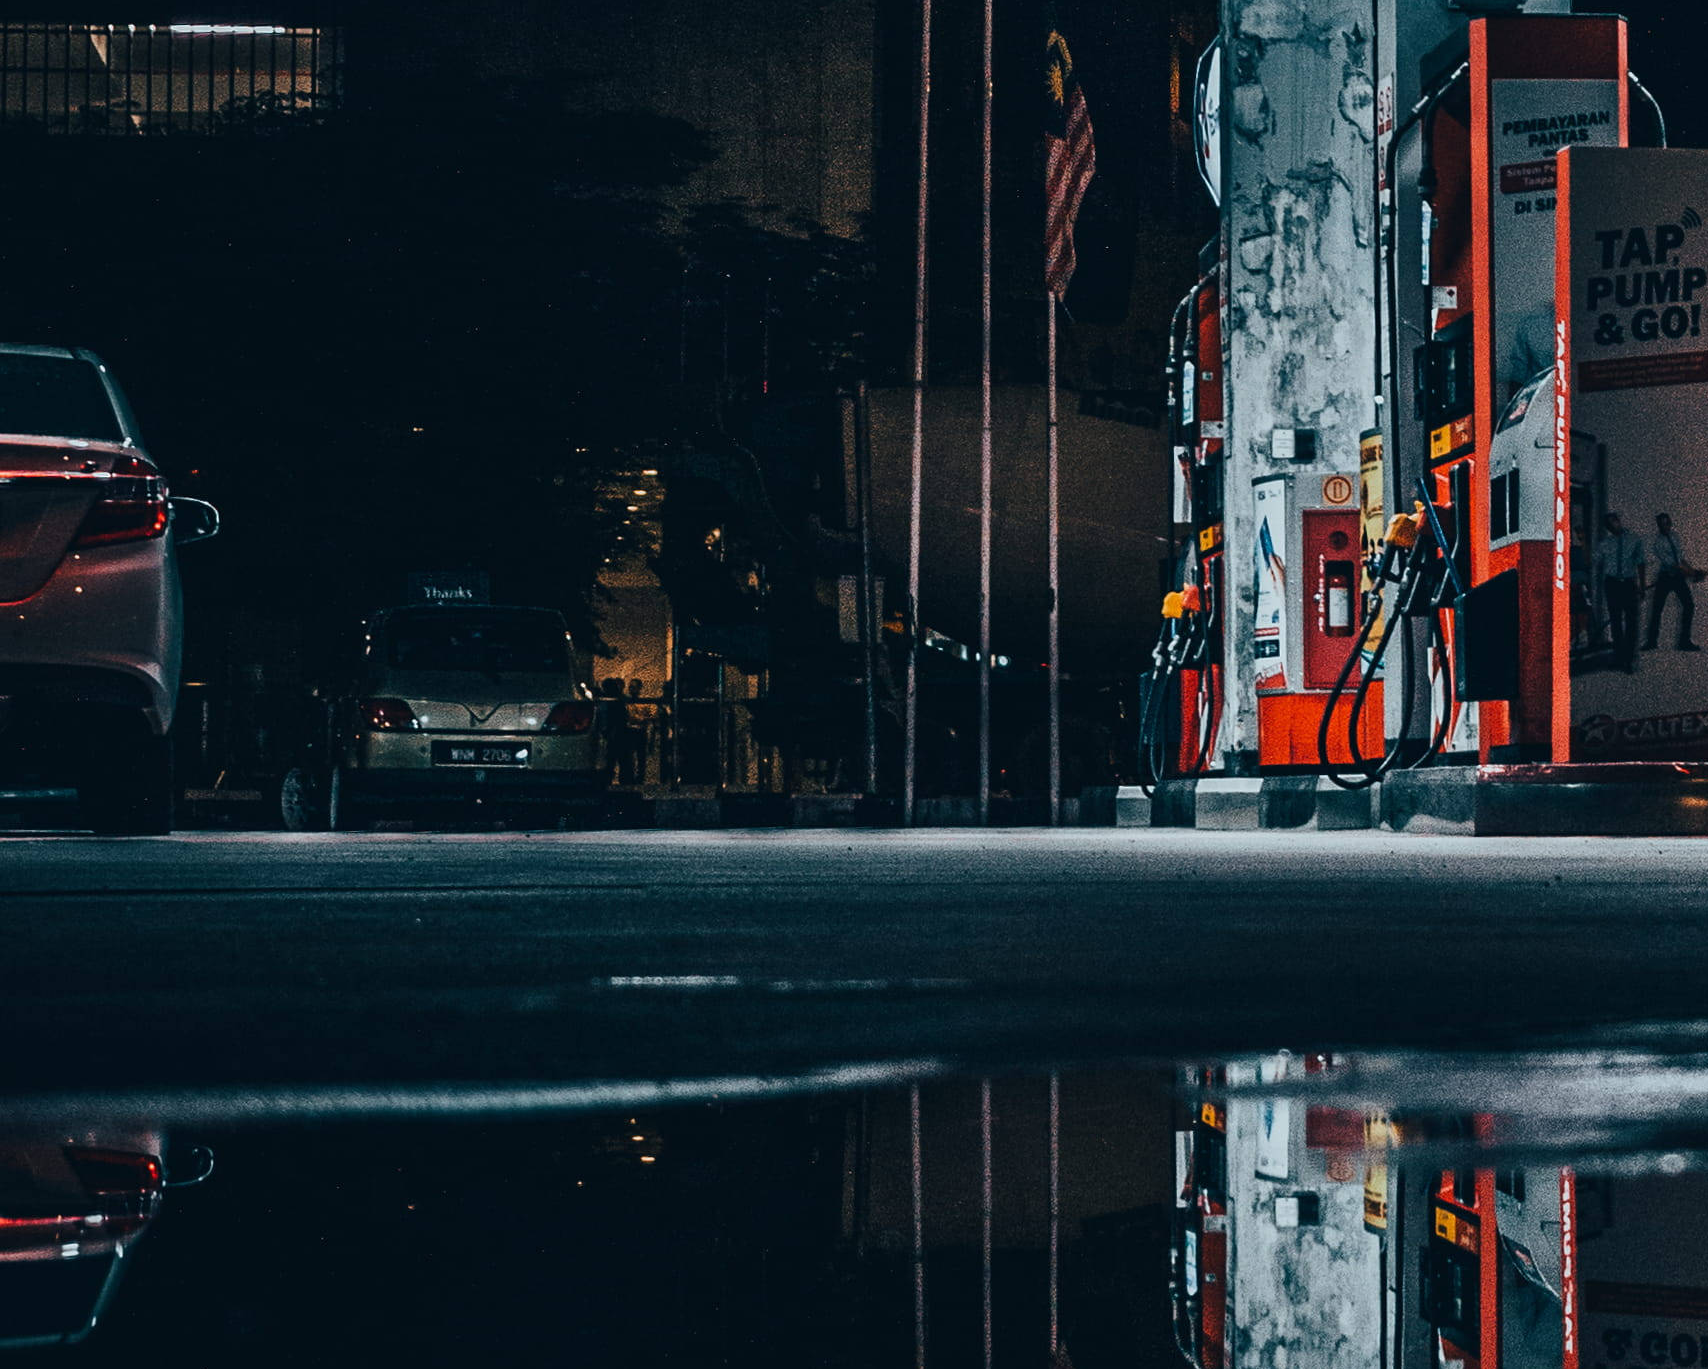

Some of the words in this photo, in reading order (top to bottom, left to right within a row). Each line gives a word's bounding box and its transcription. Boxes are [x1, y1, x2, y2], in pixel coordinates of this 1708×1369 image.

[1503, 111, 1610, 135] PEMBAYARAN
[1528, 128, 1588, 147] PANTAS
[1514, 201, 1532, 215] DI
[1587, 267, 1707, 312] PUMP
[1594, 313, 1625, 346] &
[1631, 304, 1701, 342] GO!
